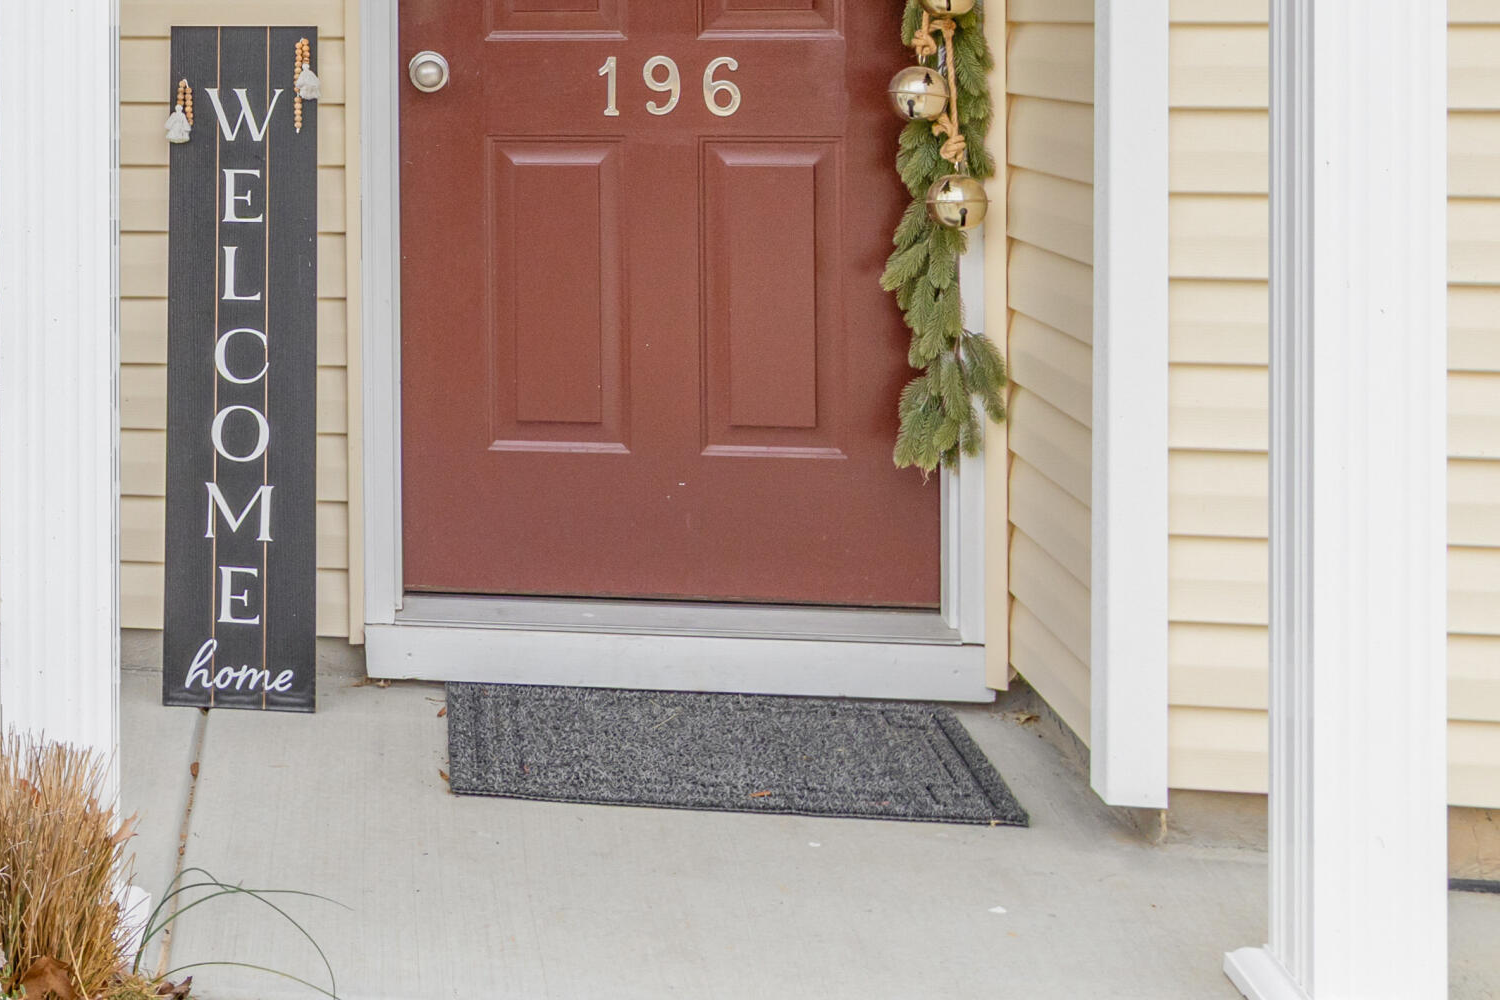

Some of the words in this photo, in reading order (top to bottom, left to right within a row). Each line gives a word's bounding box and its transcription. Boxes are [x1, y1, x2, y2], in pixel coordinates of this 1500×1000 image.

[597, 55, 742, 117] 196
[203, 87, 285, 625] WELCOME
[184, 638, 294, 692] home
